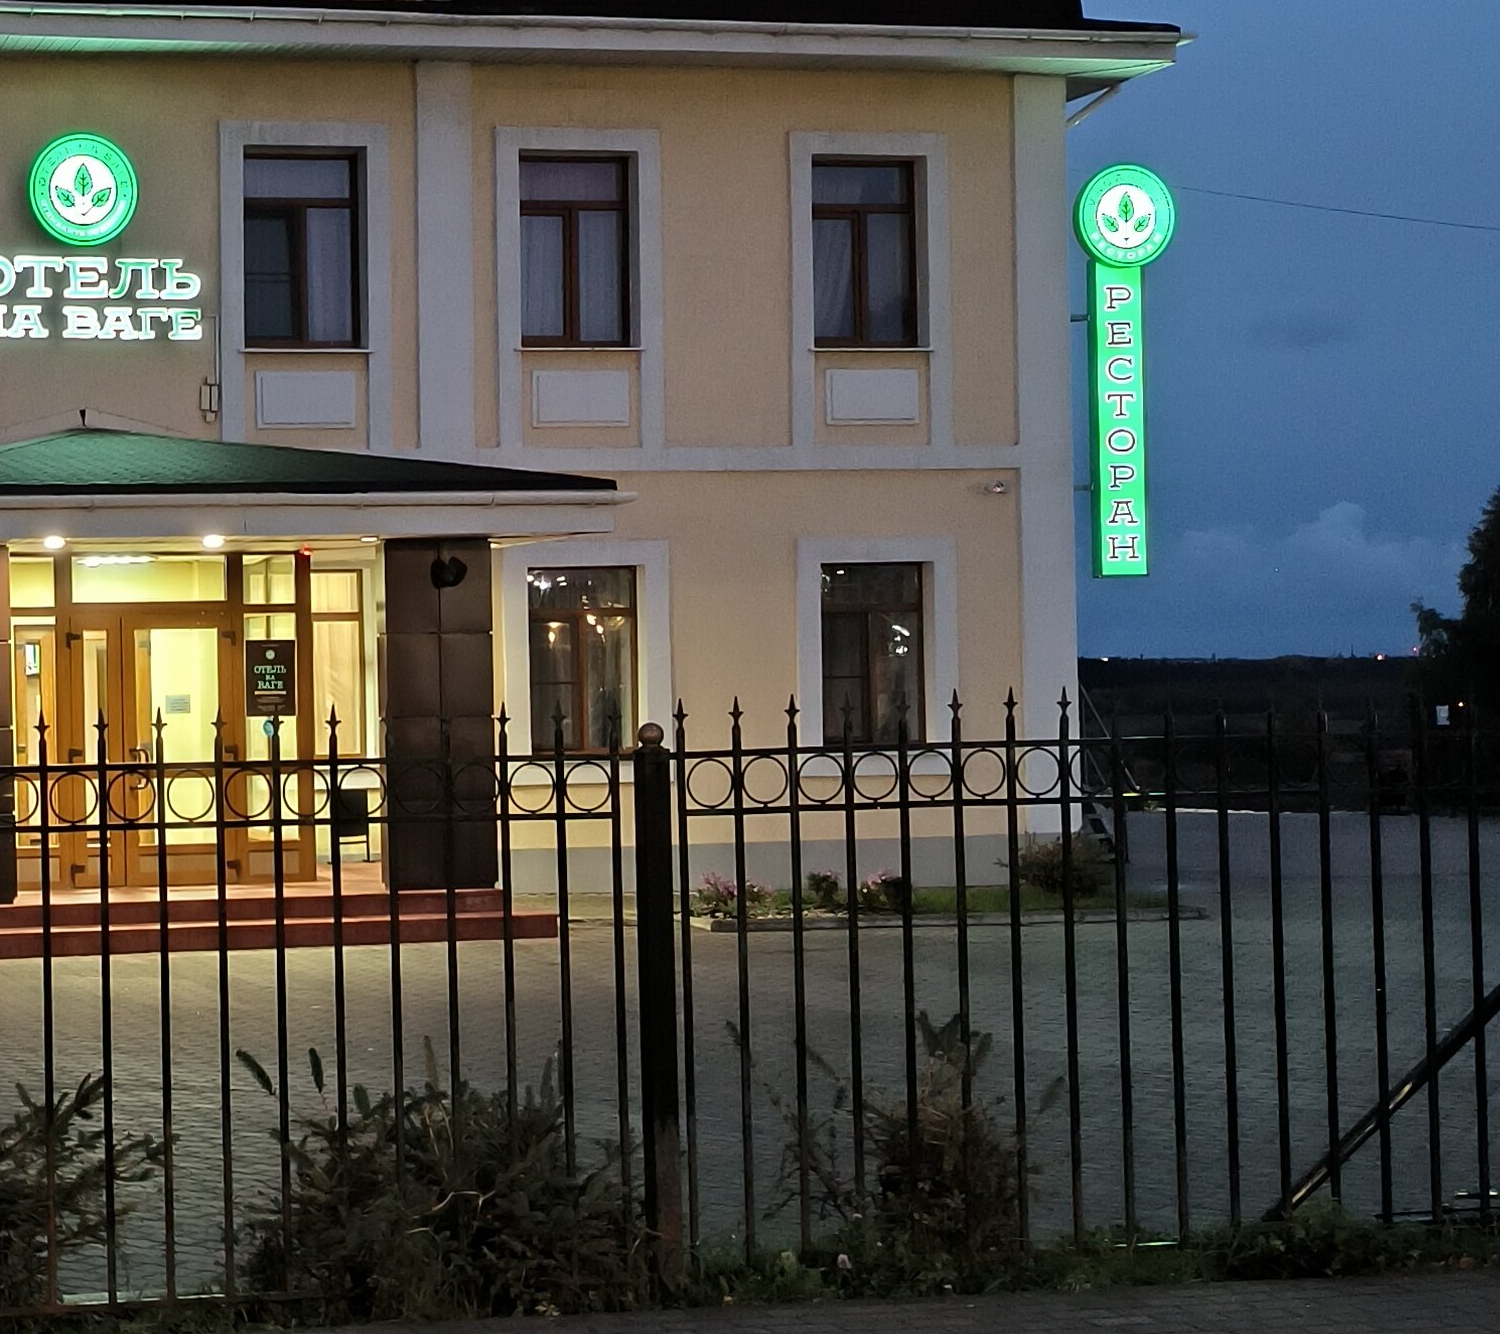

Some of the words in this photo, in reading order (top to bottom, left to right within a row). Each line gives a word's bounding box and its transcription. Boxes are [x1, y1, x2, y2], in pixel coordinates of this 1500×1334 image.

[62, 305, 202, 340] ВАГЕ
[1106, 287, 1140, 560] РЕСТОРАН
[254, 665, 287, 674] ОТЕЛЬ
